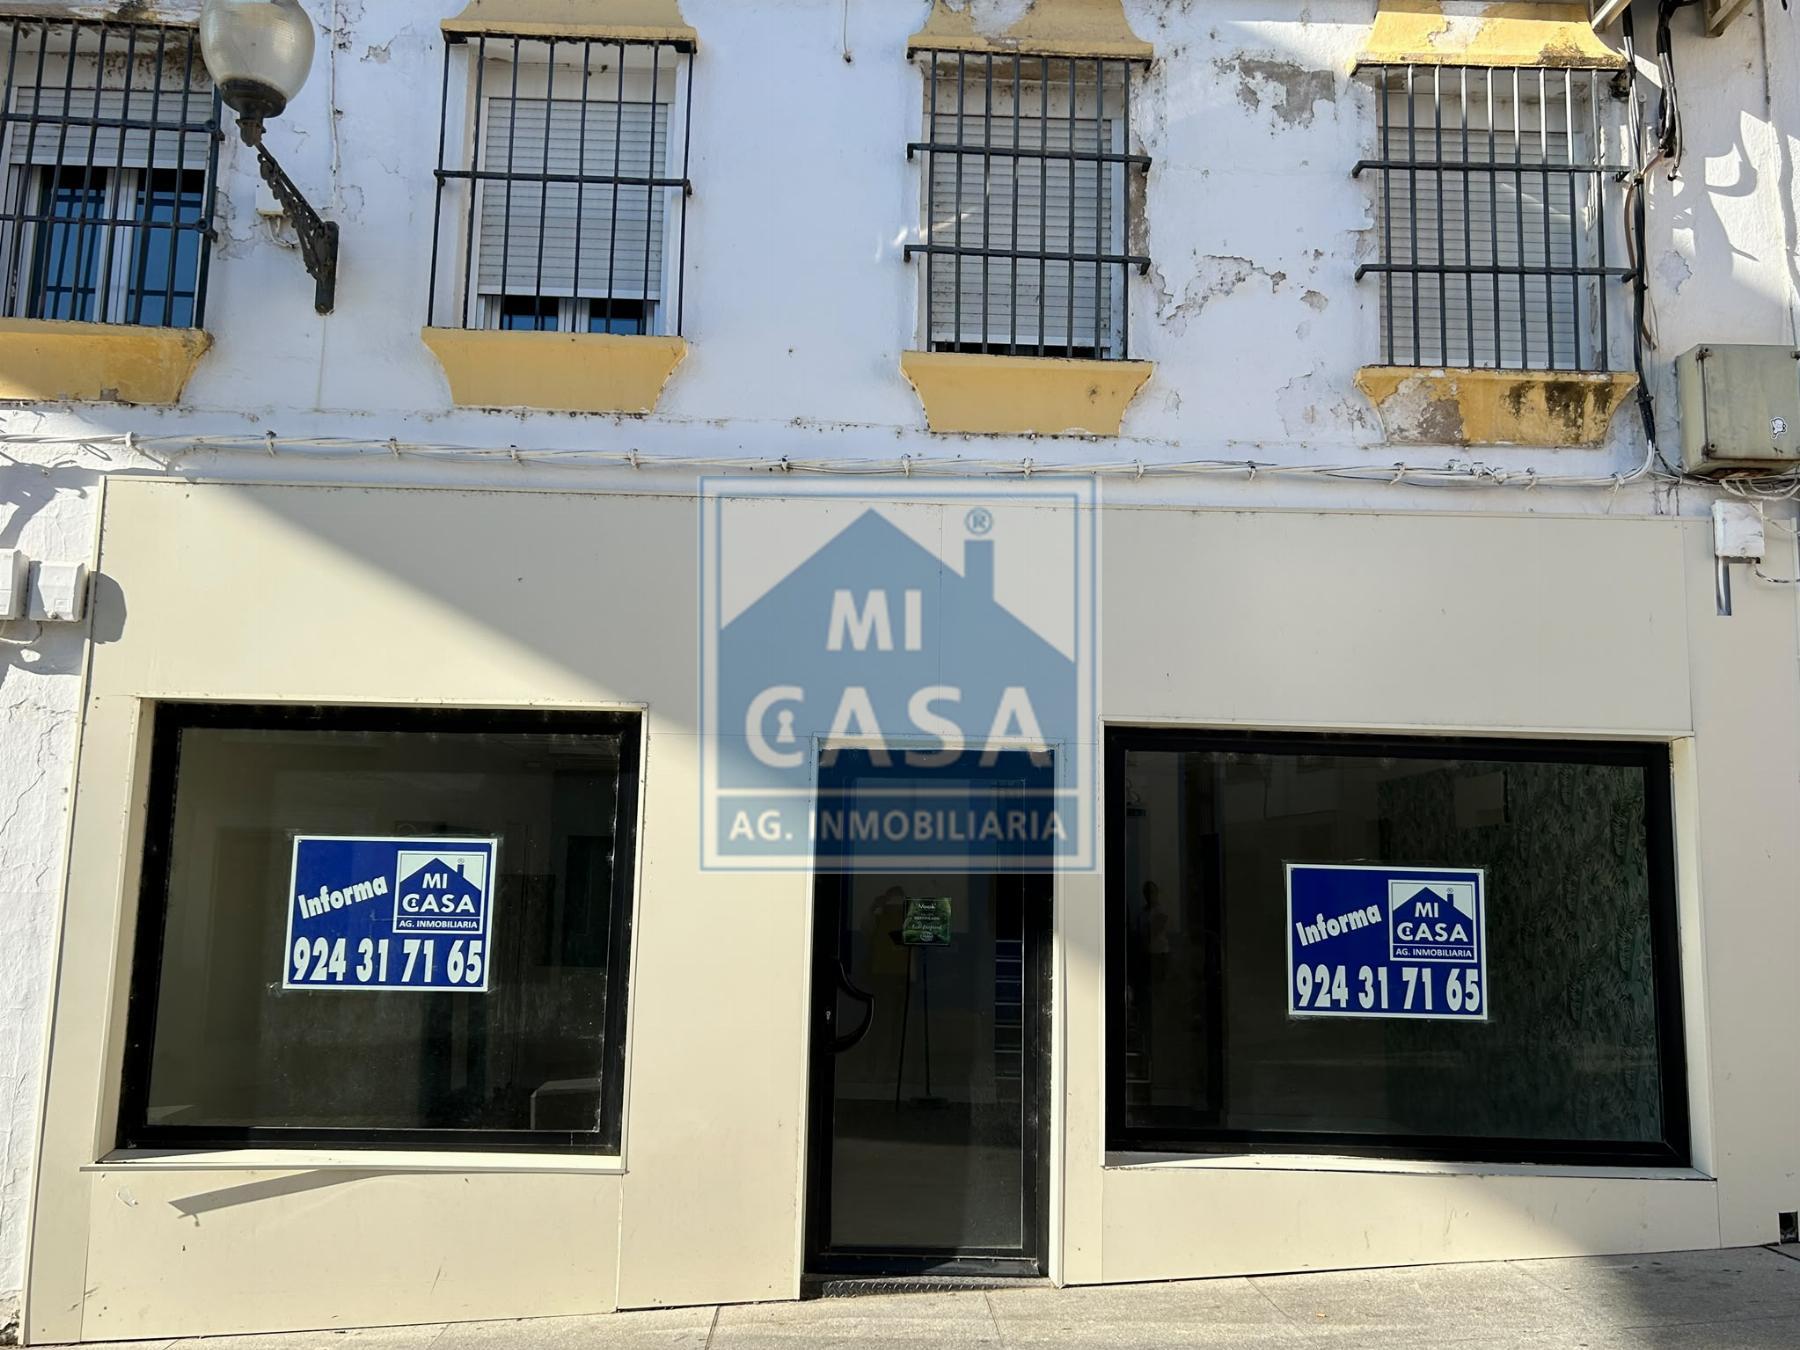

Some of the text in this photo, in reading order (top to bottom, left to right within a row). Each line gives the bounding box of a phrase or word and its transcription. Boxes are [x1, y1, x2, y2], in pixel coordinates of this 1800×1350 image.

[422, 872, 448, 889] MI
[298, 876, 389, 920] Informa
[402, 893, 475, 914] CASA
[1414, 901, 1439, 918] MI
[398, 919, 478, 929] AG. INMOBILIARIA
[1296, 904, 1383, 947] Informa
[1396, 922, 1469, 943] CASA
[292, 936, 483, 984] 924 31 71 65
[1395, 947, 1473, 958] AG. INMOBILIARIA
[1296, 963, 1480, 1012] 924 31 71 65
